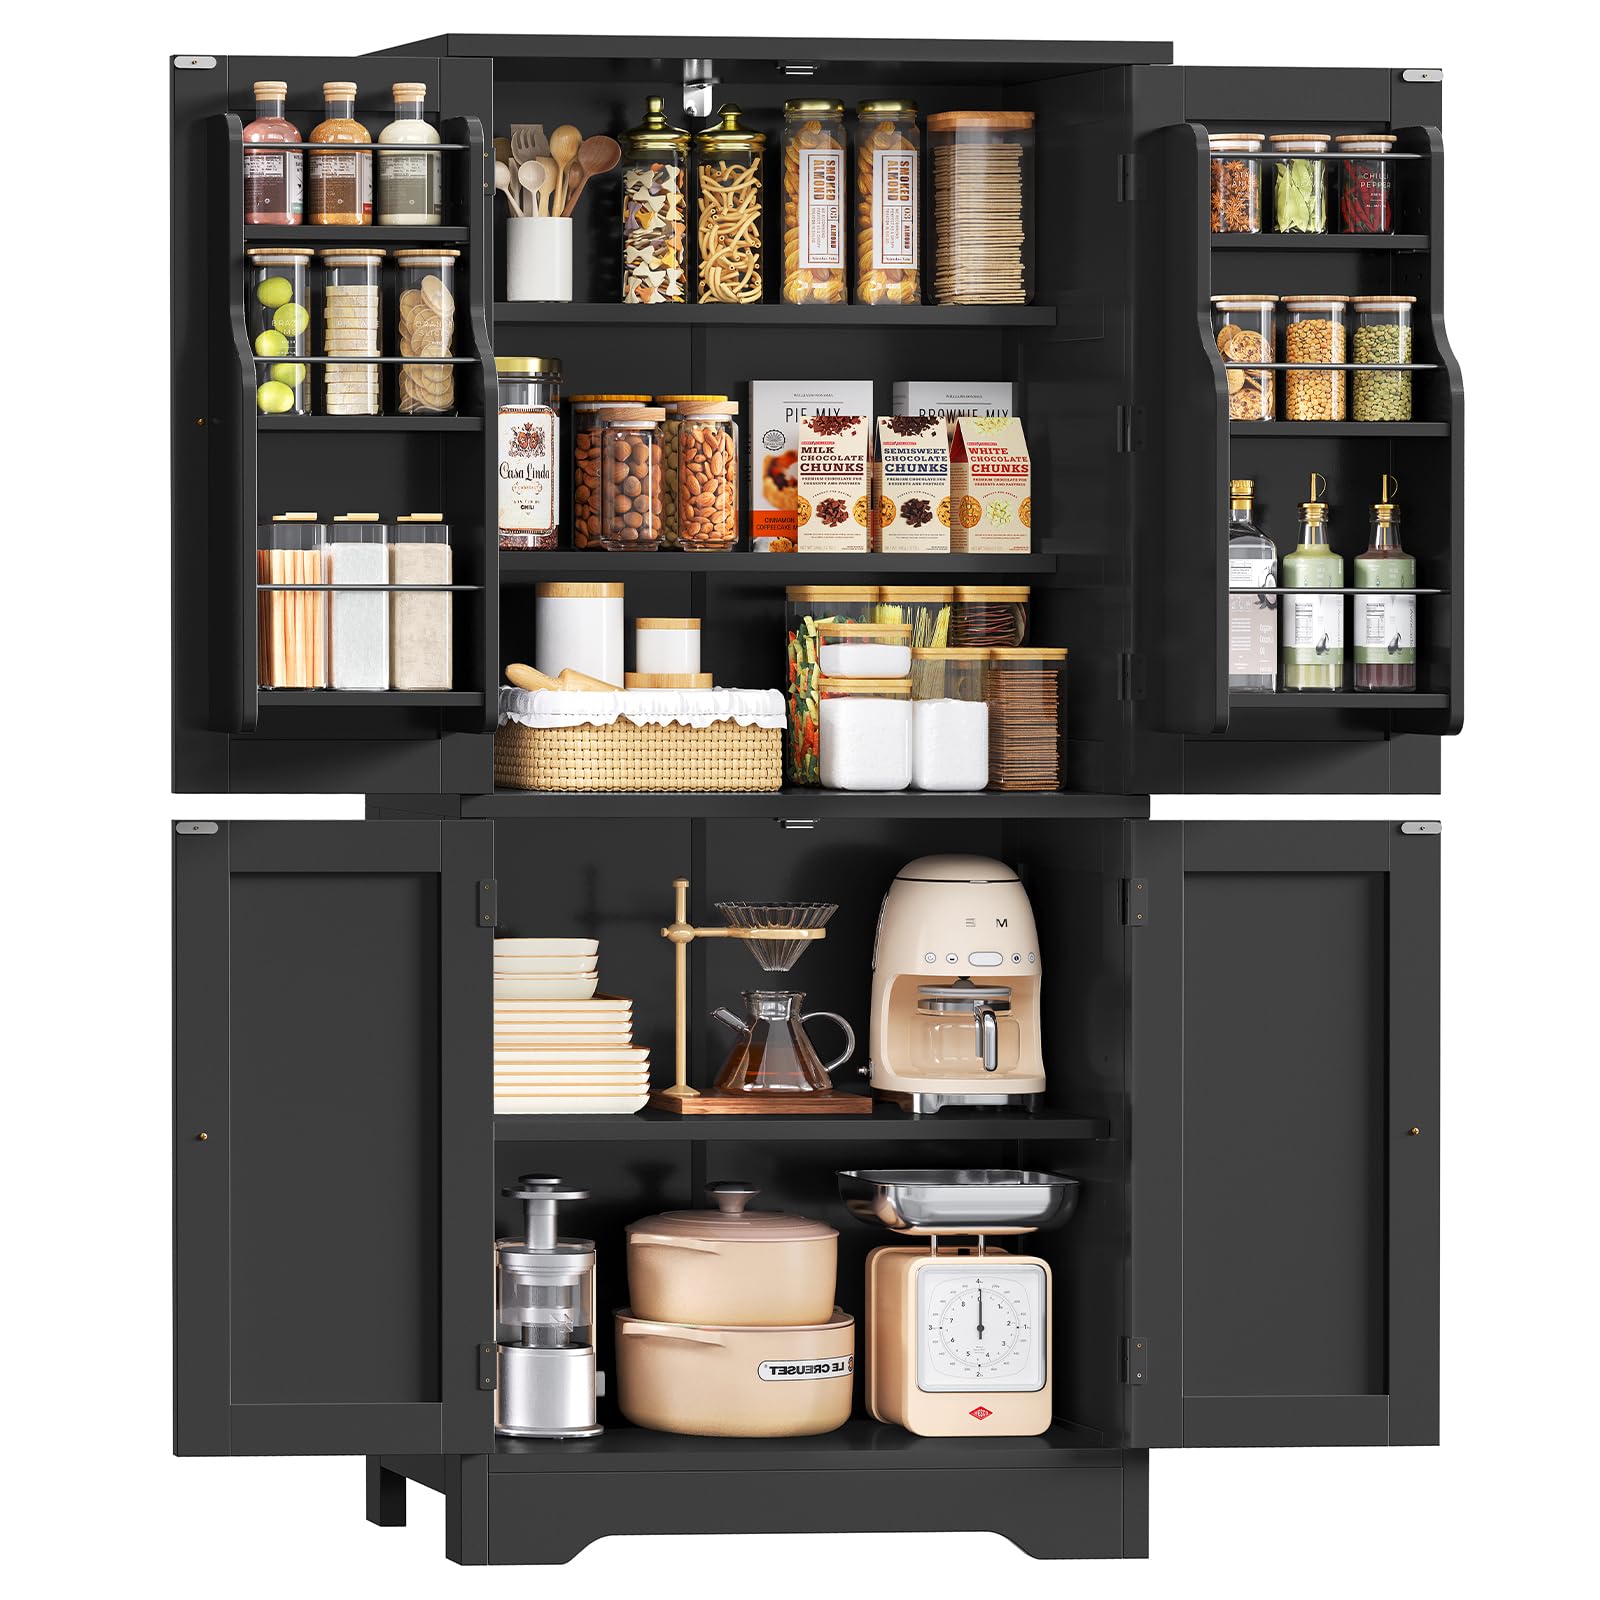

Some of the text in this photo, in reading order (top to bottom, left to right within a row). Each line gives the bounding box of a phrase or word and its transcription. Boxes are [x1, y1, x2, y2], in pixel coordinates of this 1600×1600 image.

[814, 160, 825, 200] ALMOND
[826, 160, 836, 201] SMOKED
[888, 161, 898, 201] ALMOND
[900, 161, 910, 202] SMOKED
[830, 207, 837, 219] 03
[904, 208, 911, 219] 03
[500, 461, 550, 481] Casa Linda
[800, 463, 864, 472] CHUNKS
[885, 464, 947, 472] CHUNKS
[972, 464, 1028, 472] CHUNKS
